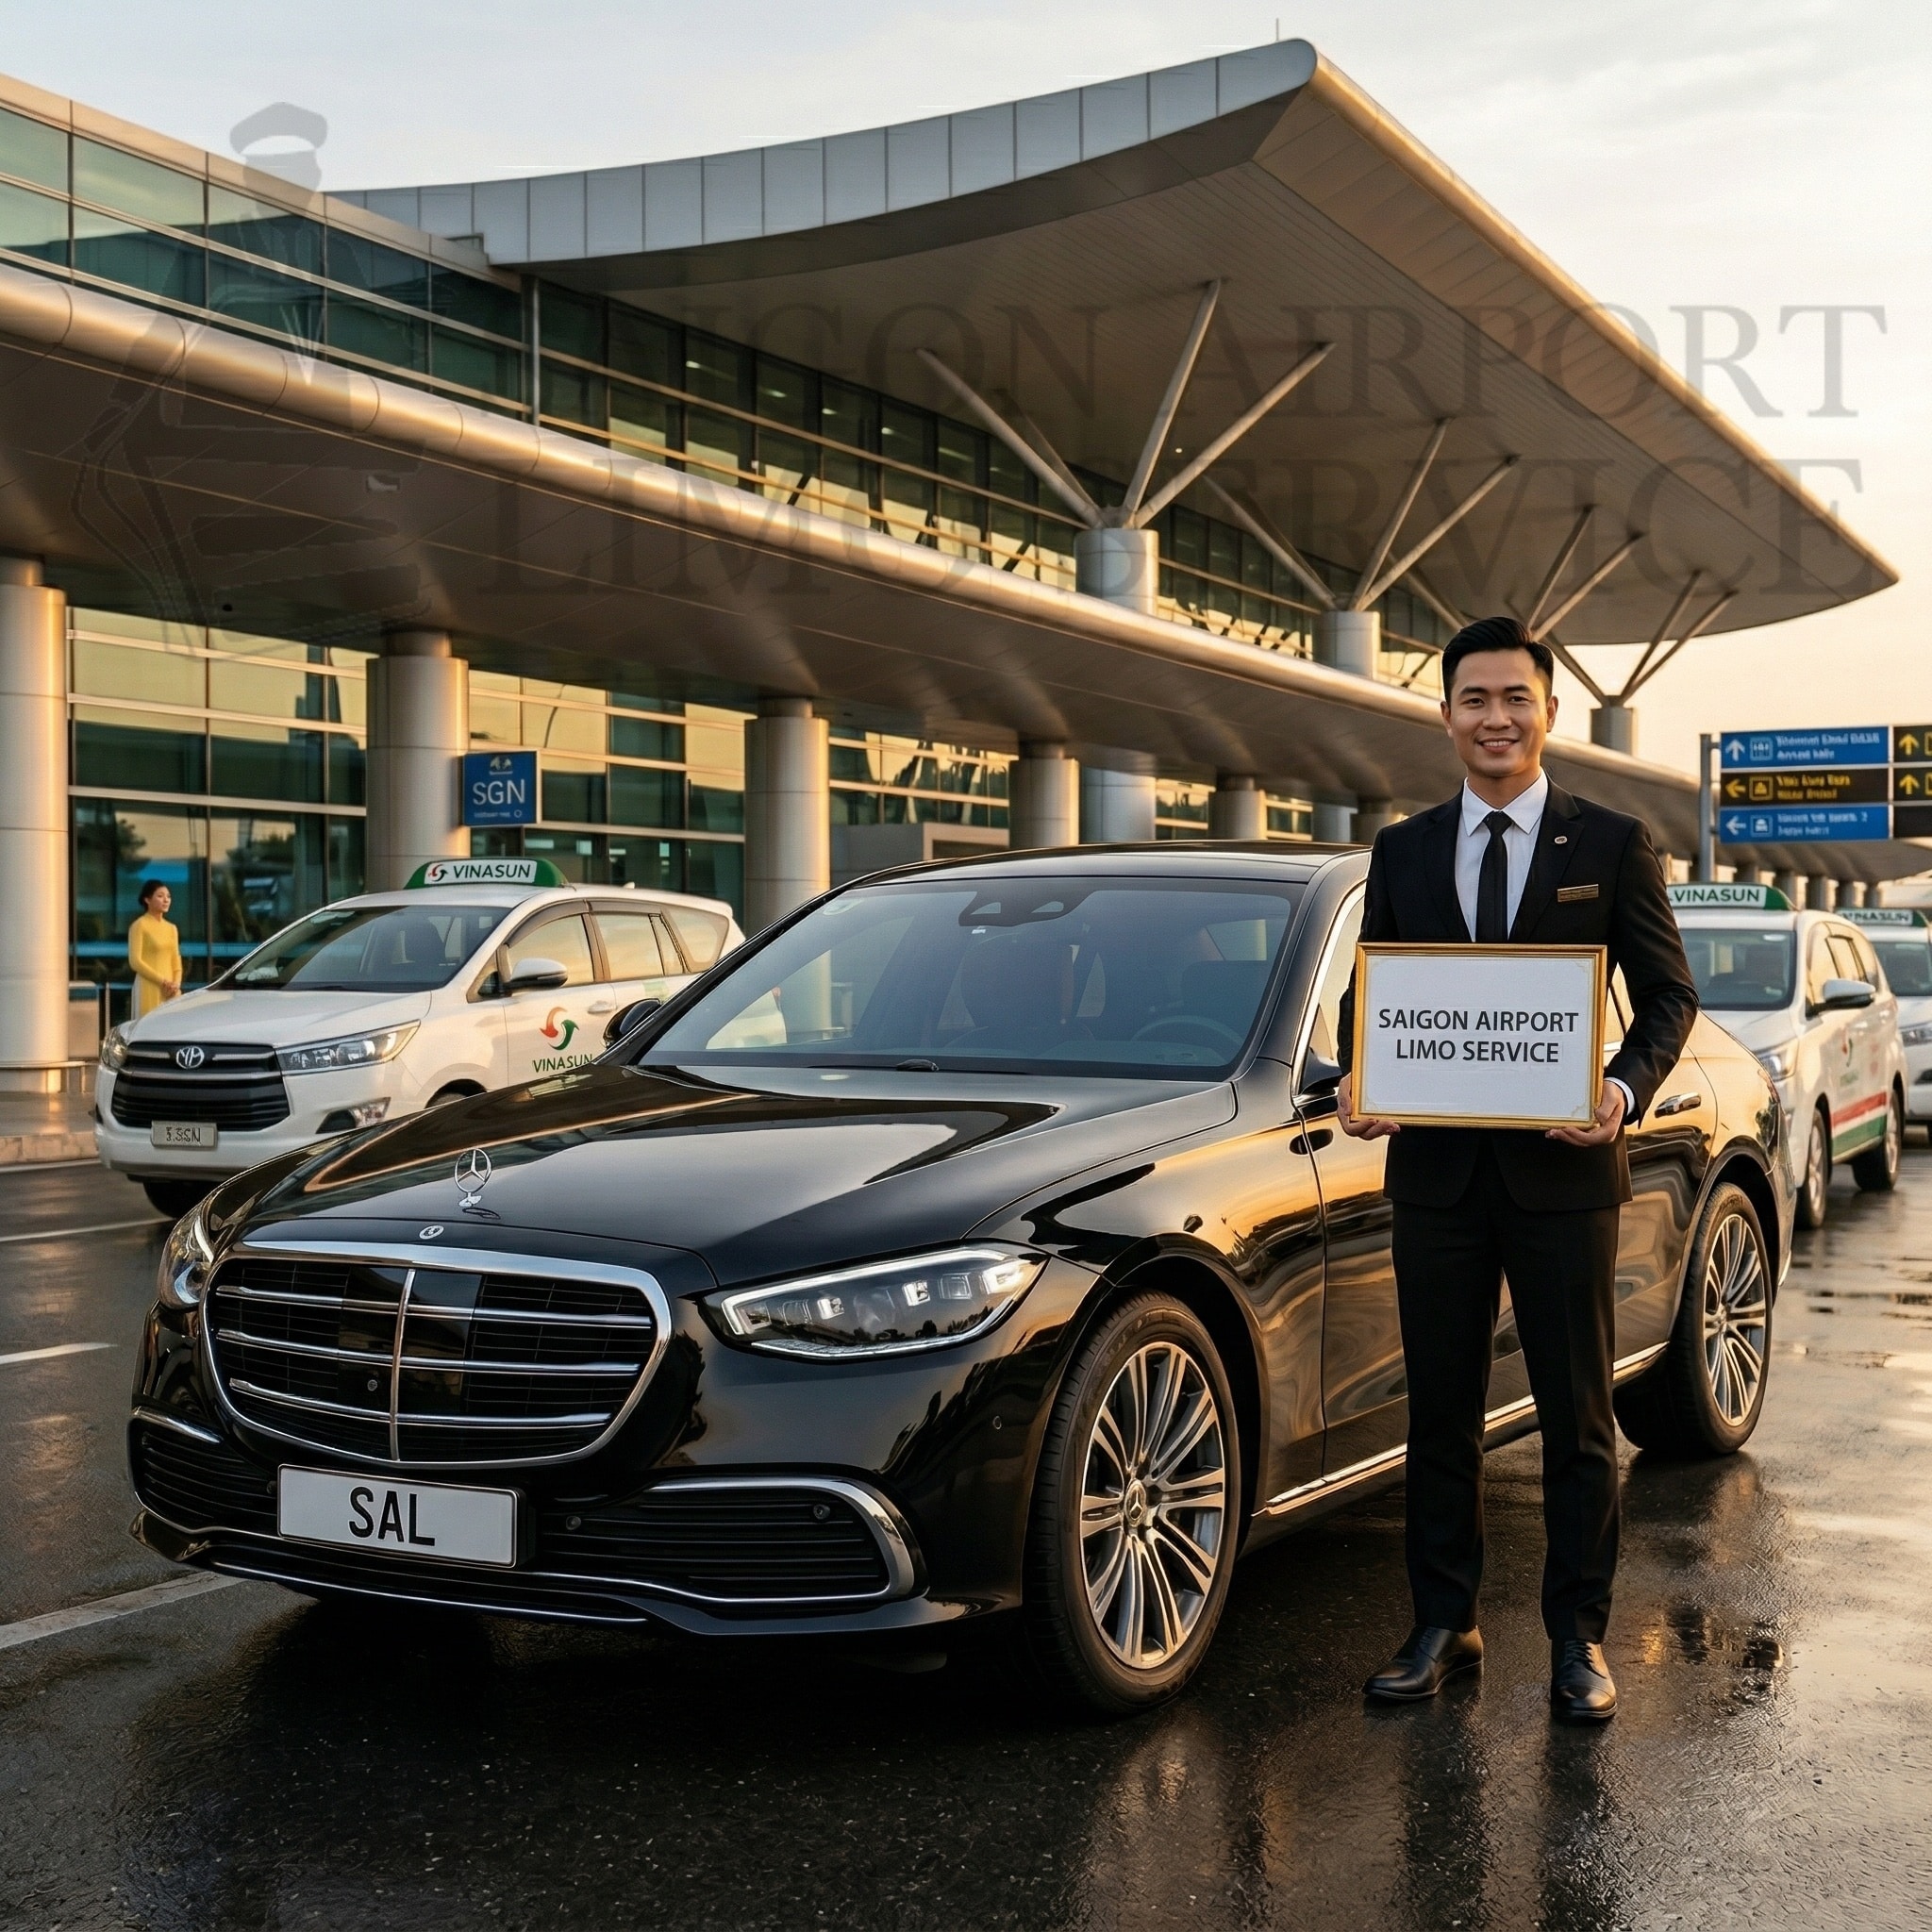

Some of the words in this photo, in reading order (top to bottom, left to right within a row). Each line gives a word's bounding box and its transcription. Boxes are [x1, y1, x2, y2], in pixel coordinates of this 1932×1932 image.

[473, 778, 525, 805] SGN
[453, 864, 530, 878] VINASUN
[1674, 889, 1759, 902] VINASUN
[1378, 1008, 1468, 1030] SAIGON
[1475, 1010, 1578, 1032] AIRPORT
[1396, 1039, 1456, 1060] LIMO
[1462, 1041, 1558, 1062] SERVICE
[532, 1054, 592, 1073] VINASUN
[348, 1486, 435, 1547] SAL
